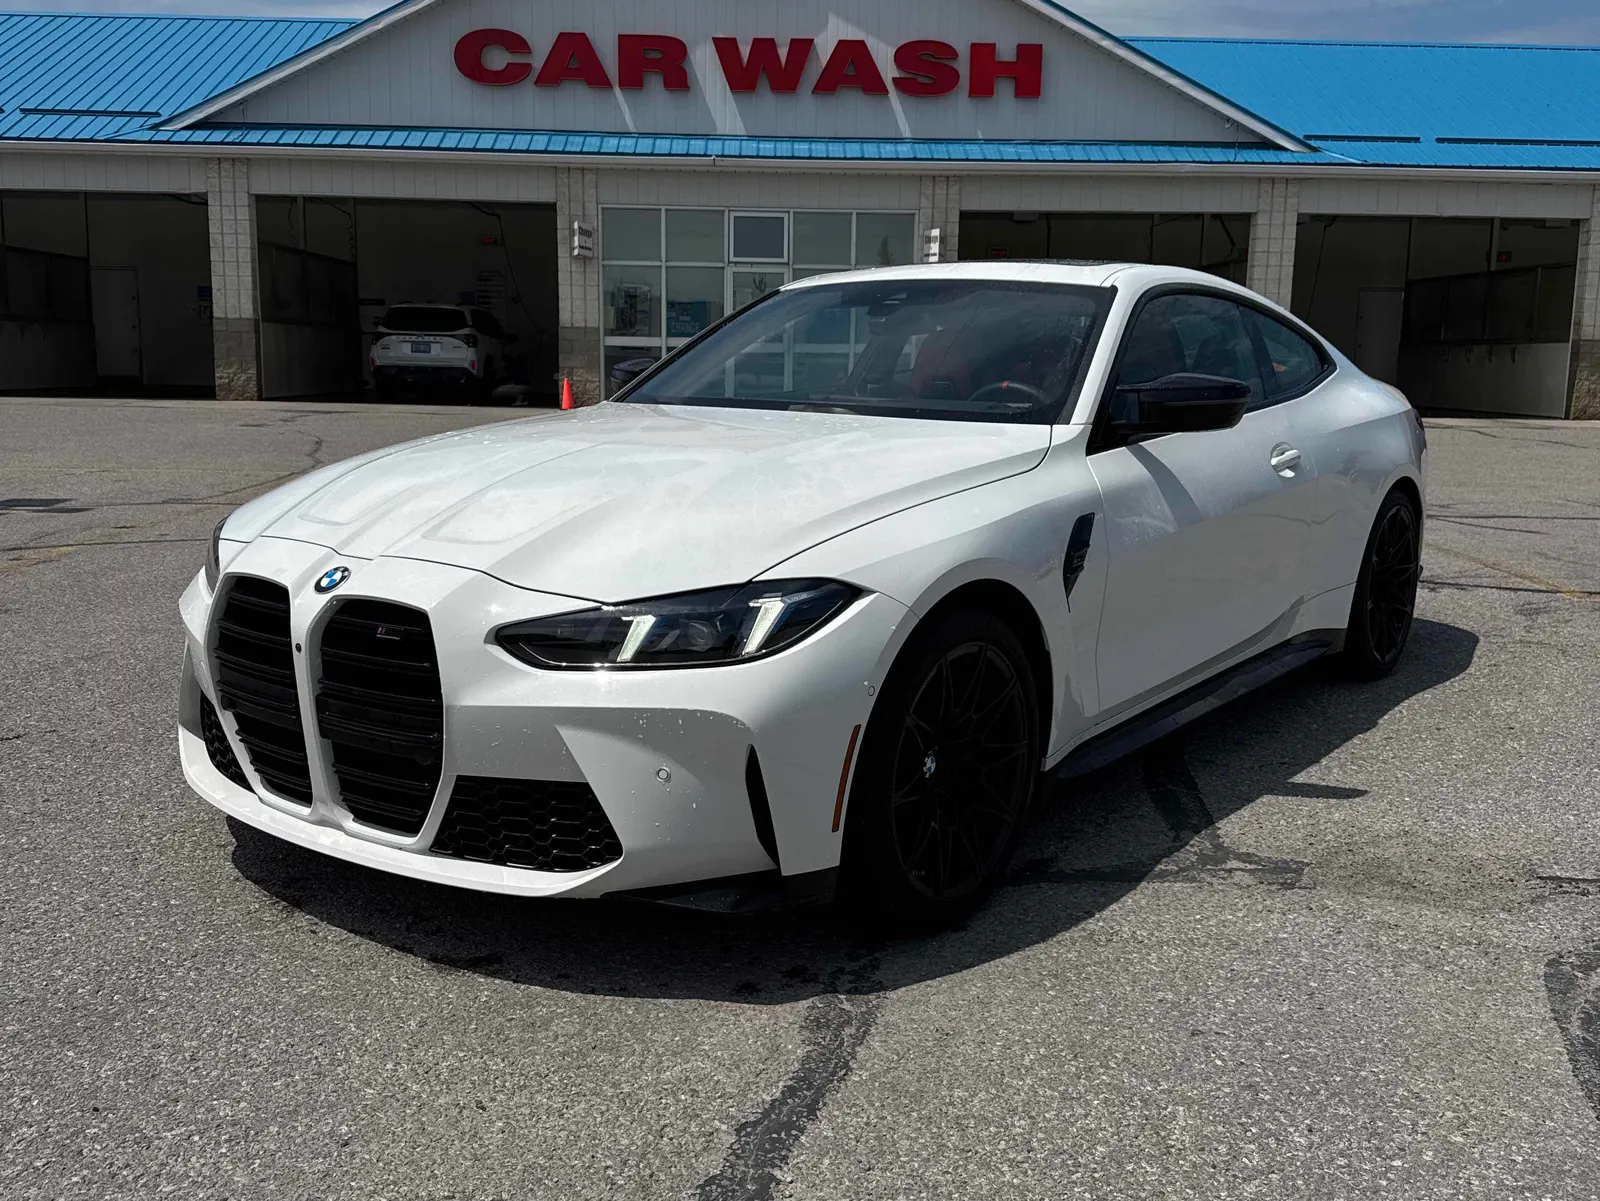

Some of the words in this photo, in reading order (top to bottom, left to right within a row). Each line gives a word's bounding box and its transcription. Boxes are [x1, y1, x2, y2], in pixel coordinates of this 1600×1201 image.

[453, 28, 691, 92] CAR
[711, 36, 1044, 98] WASH
[671, 322, 700, 333] CHANGE
